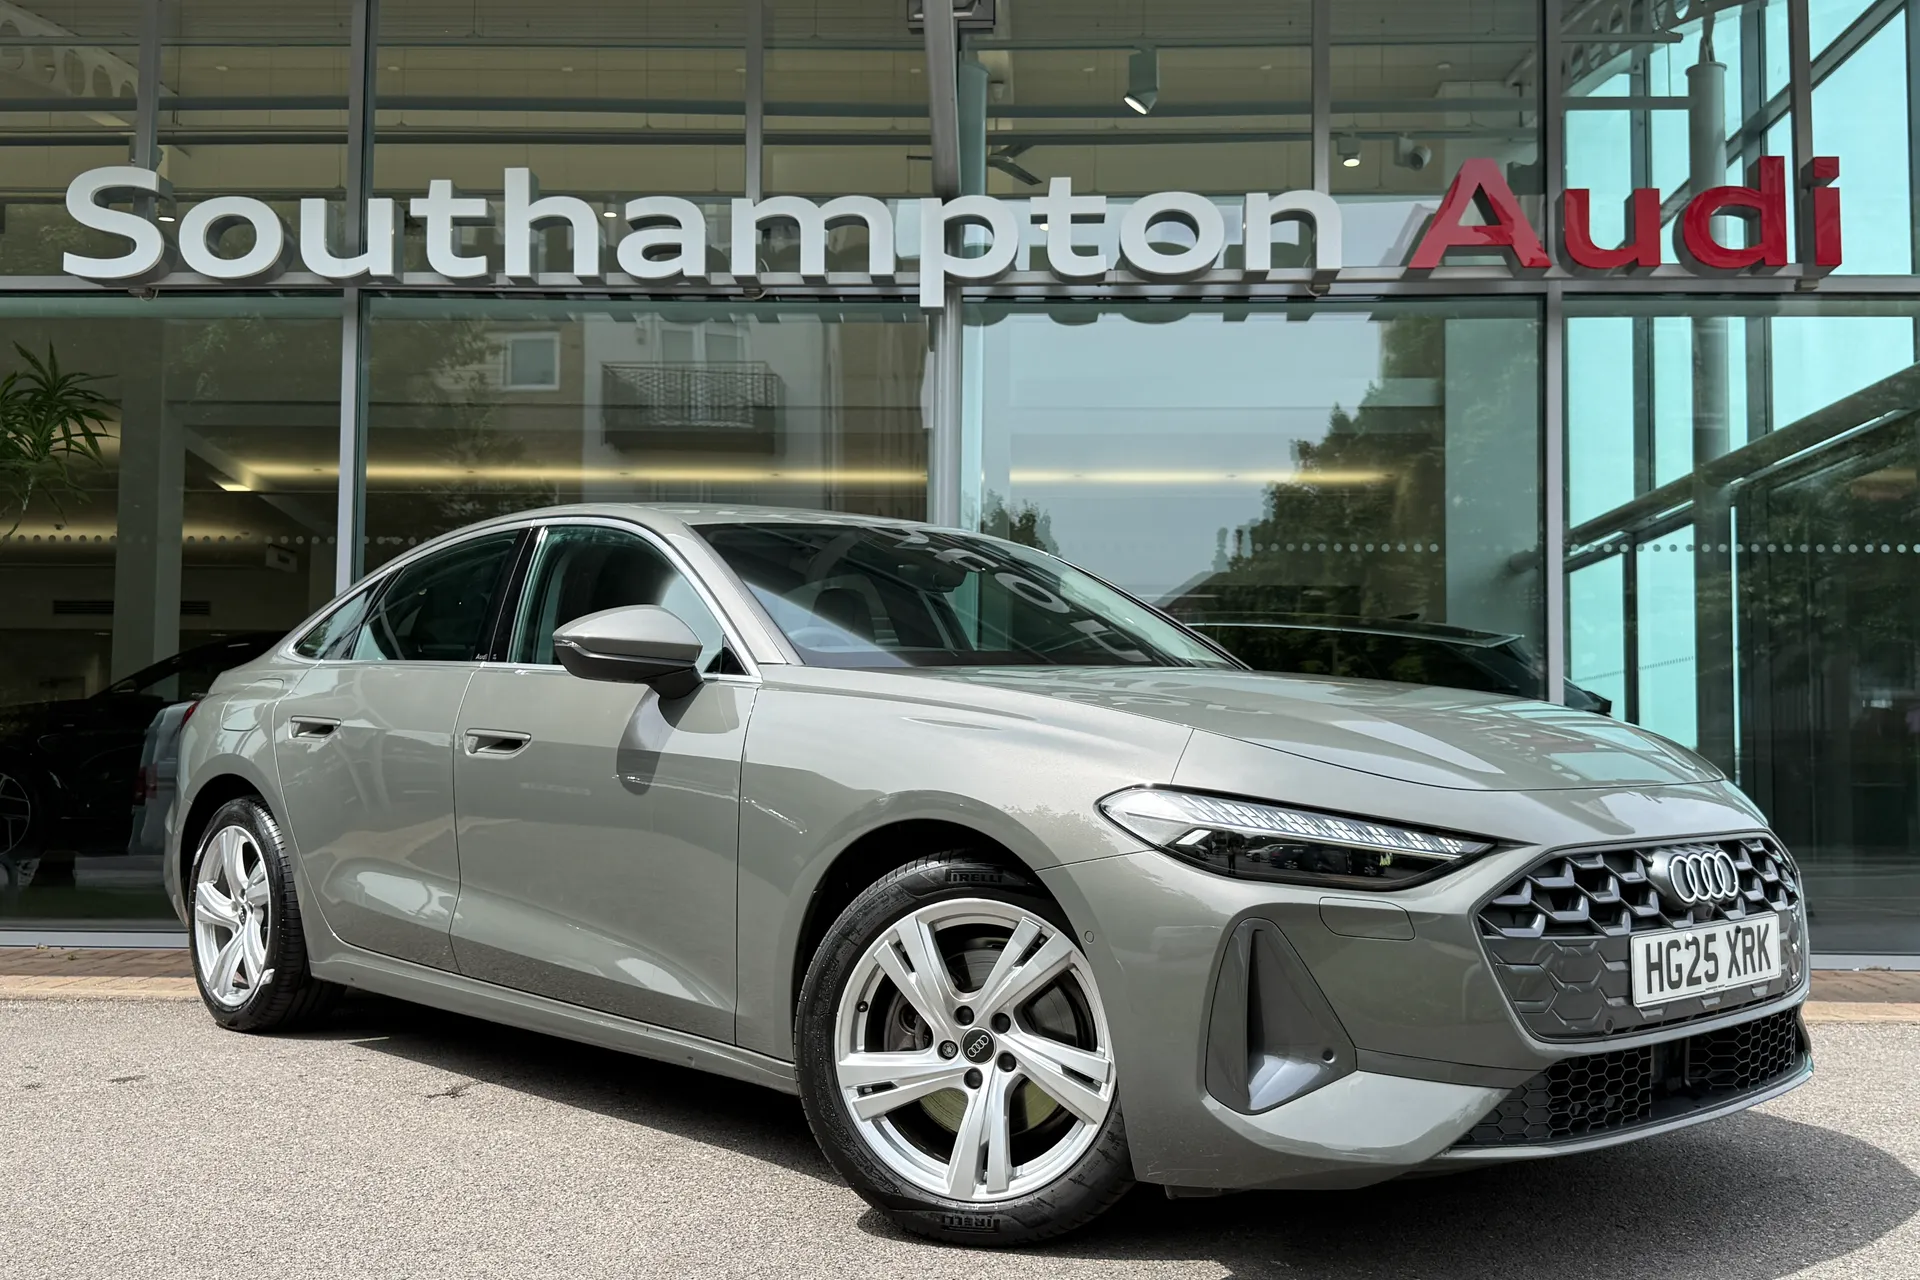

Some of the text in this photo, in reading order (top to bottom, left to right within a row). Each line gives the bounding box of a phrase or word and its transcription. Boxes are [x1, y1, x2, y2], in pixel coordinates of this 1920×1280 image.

[63, 156, 1841, 307] Southampton Audi
[1645, 923, 1772, 994] HG25 XRK
